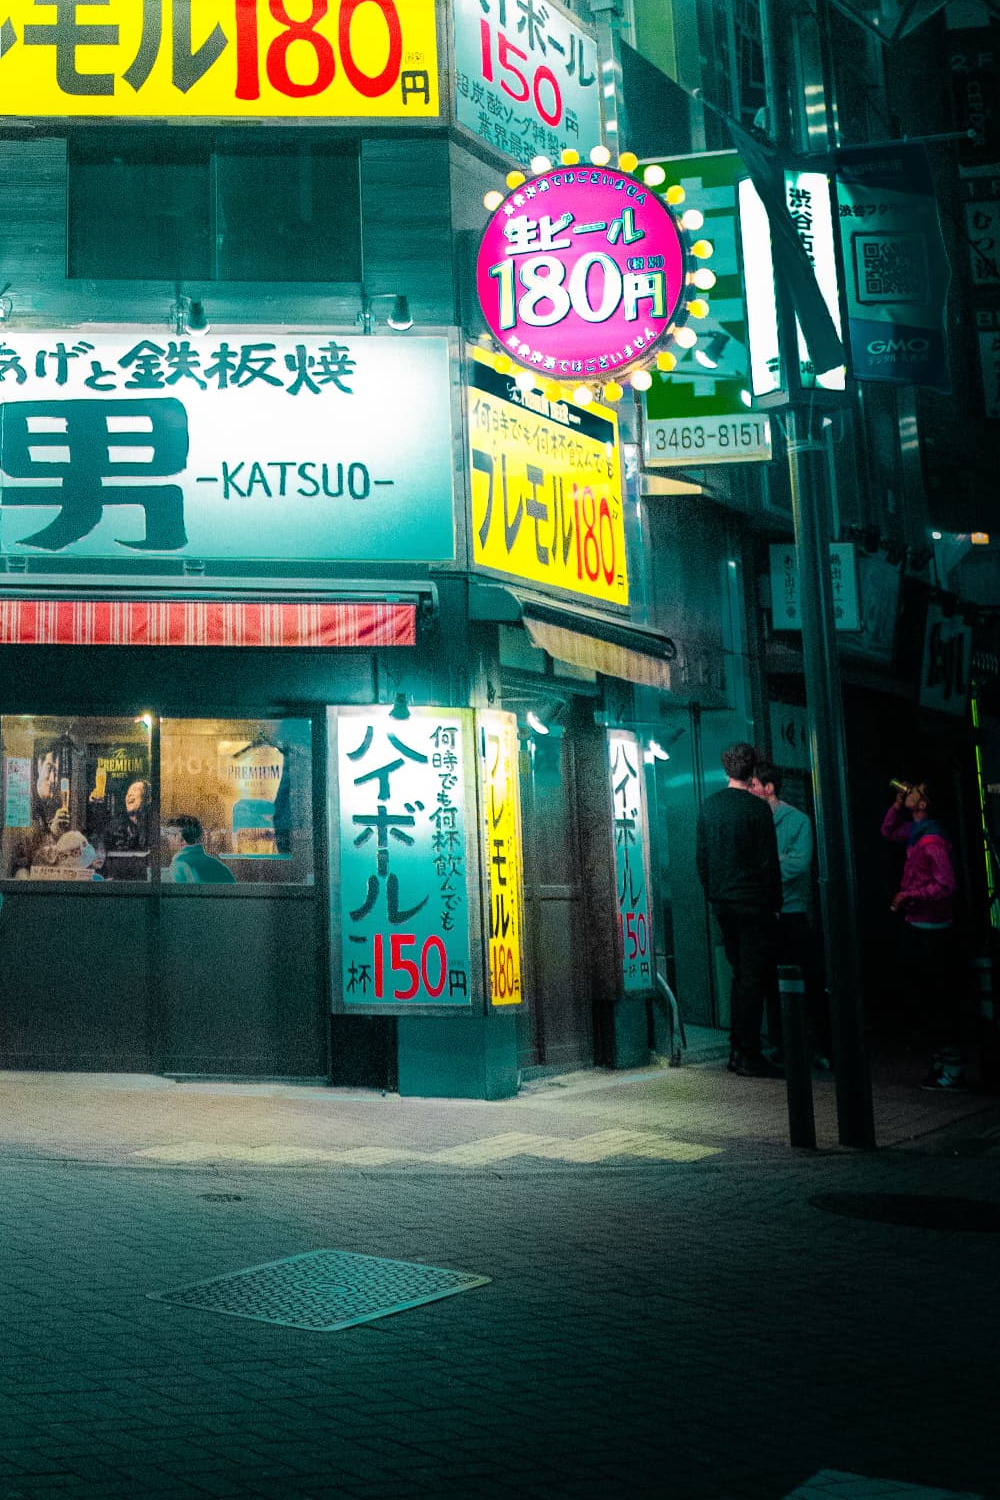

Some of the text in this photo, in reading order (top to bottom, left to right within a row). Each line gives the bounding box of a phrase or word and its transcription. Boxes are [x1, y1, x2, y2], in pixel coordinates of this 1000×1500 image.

[504, 207, 645, 256] 生ビール
[866, 339, 930, 355] GMO
[655, 422, 761, 451] 3463-8151
[346, 725, 430, 925] ハイボール
[429, 725, 462, 932] 何時でも何杯飲んでも
[612, 743, 643, 910] ハイボール
